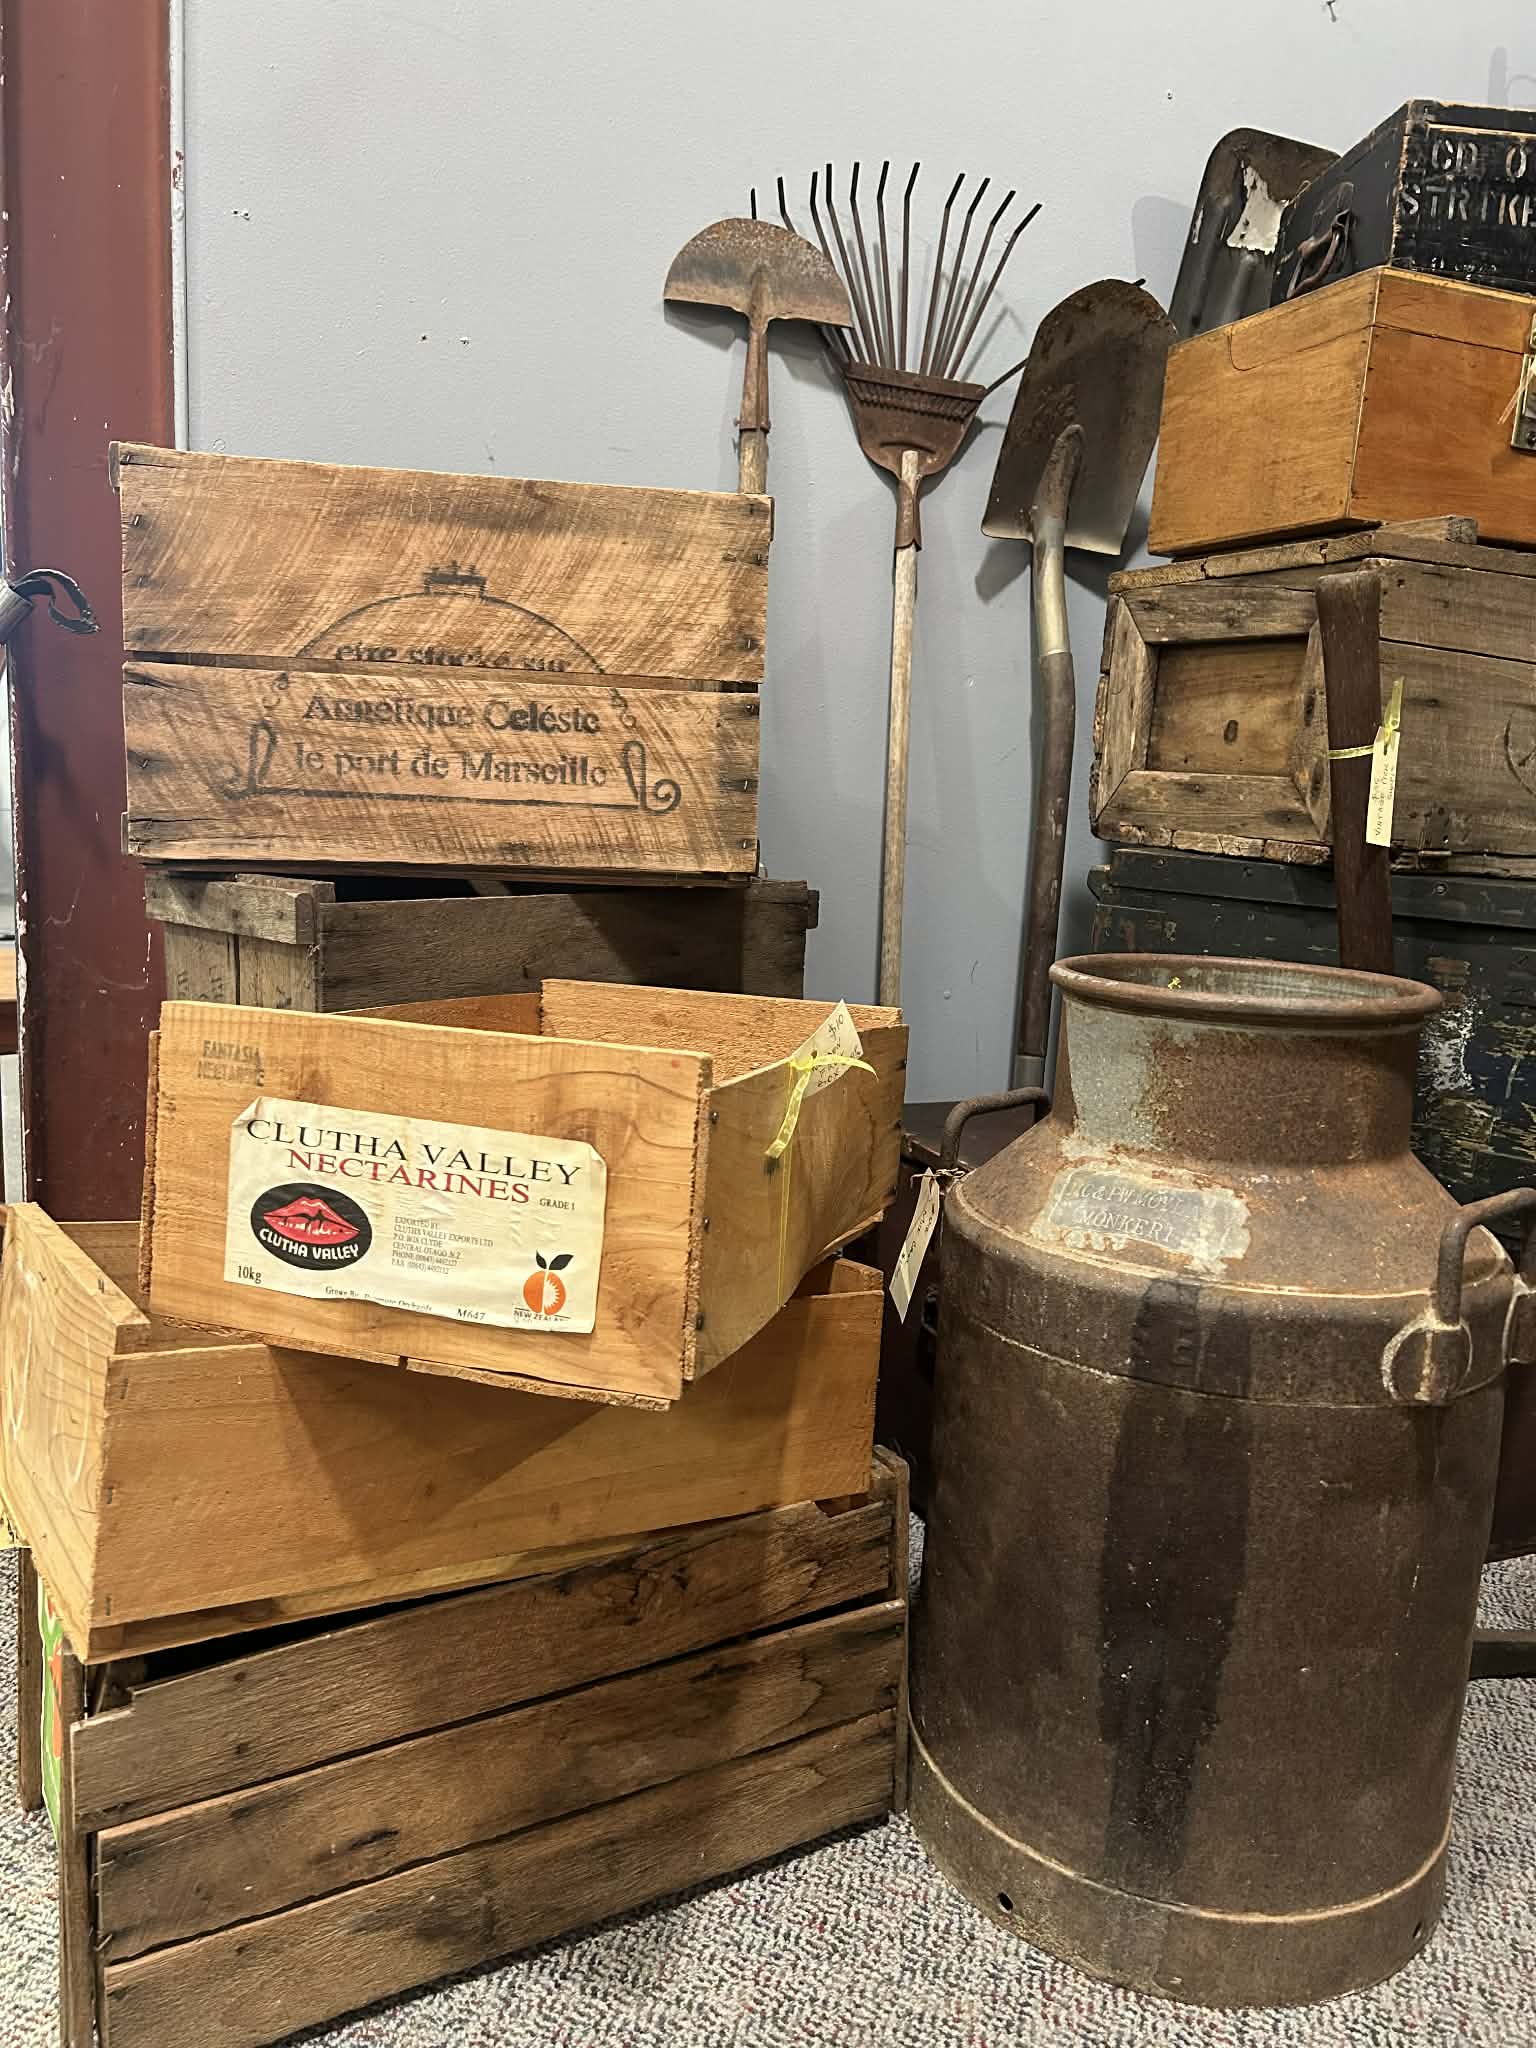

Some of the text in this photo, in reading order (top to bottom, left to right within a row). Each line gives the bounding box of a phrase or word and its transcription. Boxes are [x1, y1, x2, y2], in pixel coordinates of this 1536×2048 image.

[334, 749, 401, 776] port
[410, 745, 449, 779] de
[460, 750, 608, 787] Marseille
[246, 1119, 582, 1186] CLUTHA VALLEY
[287, 1148, 530, 1204] NECTARINES
[539, 1198, 570, 1210] GRADE
[259, 1228, 360, 1260] CLUTHA VALLEY
[237, 1265, 262, 1284] 10kg
